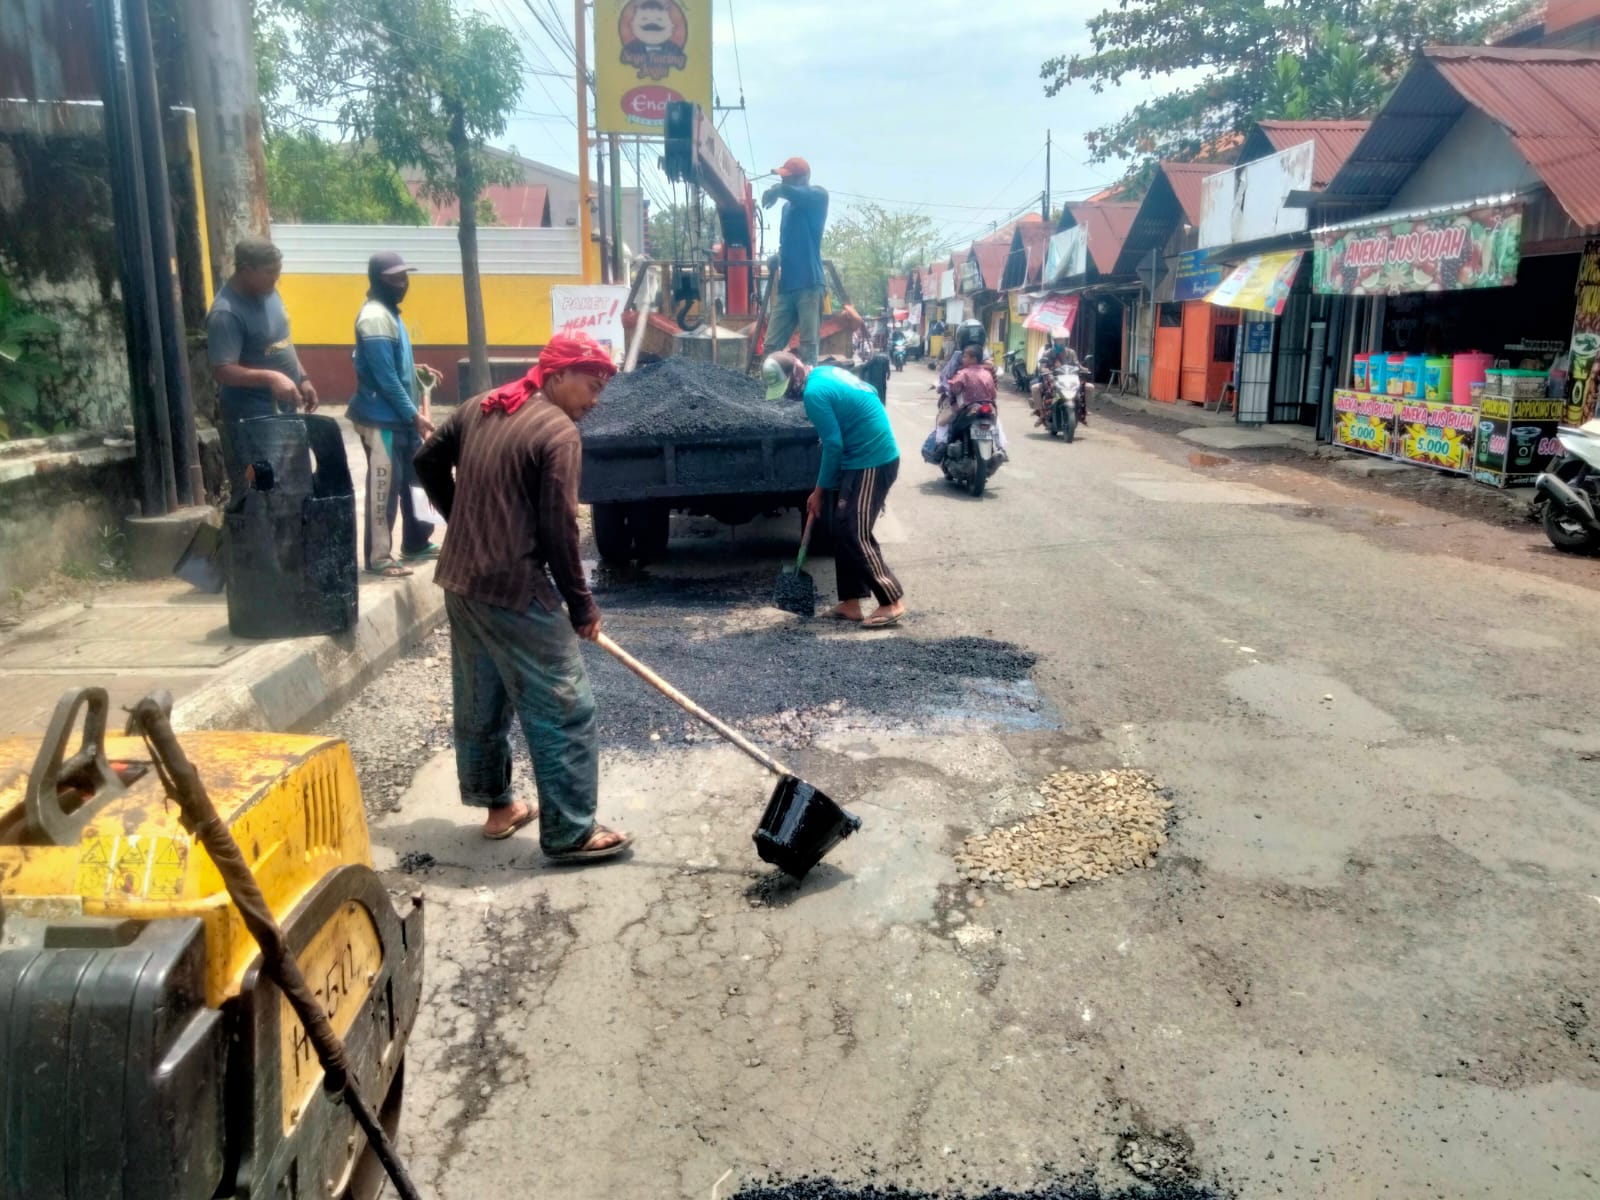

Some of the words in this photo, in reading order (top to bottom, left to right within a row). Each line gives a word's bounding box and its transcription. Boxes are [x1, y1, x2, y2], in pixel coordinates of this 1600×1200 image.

[1344, 237, 1388, 267] ANEKA
[1388, 231, 1418, 264] JUS
[1418, 227, 1466, 262] BUAH
[1335, 395, 1358, 413] ANEKA
[1358, 399, 1373, 415] JUS
[1372, 401, 1395, 419] BUAH
[1400, 405, 1428, 425] ANEKA
[1428, 408, 1447, 427] JUS
[1447, 411, 1475, 432] BUAH
[1350, 425, 1376, 441] 5.000
[1417, 437, 1450, 456] 5.000
